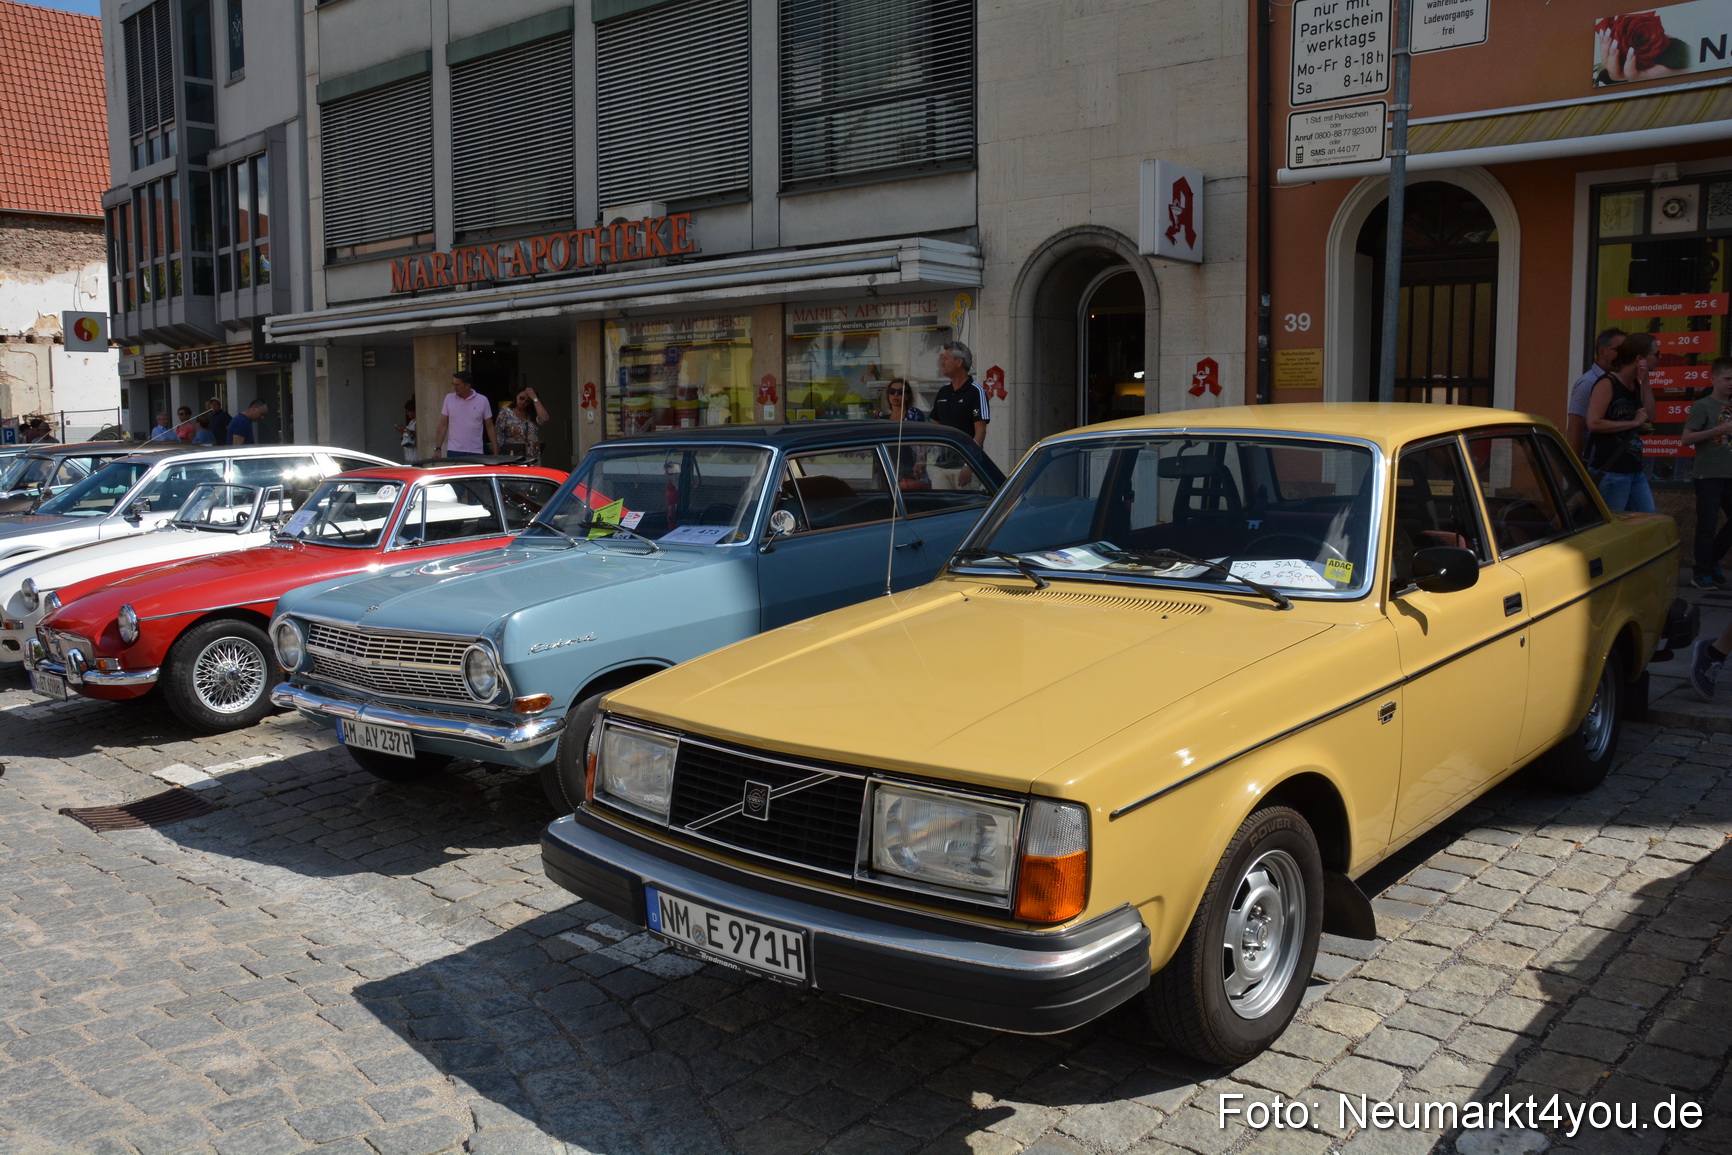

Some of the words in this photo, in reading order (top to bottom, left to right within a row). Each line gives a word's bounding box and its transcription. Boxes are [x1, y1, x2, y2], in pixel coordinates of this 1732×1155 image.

[1314, 2, 1338, 17] nur
[1301, 10, 1383, 37] Parkschein
[1424, 9, 1474, 25] Ladevorgangs
[1442, 25, 1455, 36] frei
[1307, 31, 1376, 53] werktags
[1297, 59, 1338, 77] Mo-Fr
[1297, 82, 1312, 95] Sa
[1334, 110, 1369, 121] Parkschein
[1295, 133, 1314, 142] Anruf
[1310, 148, 1326, 157] SMS
[389, 212, 696, 293] MARIEN-APOTHEKE
[794, 305, 848, 321] MARIEN
[854, 299, 939, 318] APOTHEKE
[1624, 302, 1684, 313] Neumodellage
[1695, 299, 1708, 309] 25
[1710, 299, 1718, 308] €
[629, 318, 674, 335] MARIEN
[679, 313, 747, 331] APOTHEKE
[865, 319, 886, 329] gesund
[1284, 312, 1312, 332] 39
[1678, 336, 1690, 345] 20
[1692, 336, 1700, 345] €
[169, 349, 209, 369] ESPRIT
[1684, 371, 1698, 380] 29
[1701, 371, 1709, 379] €
[1668, 406, 1682, 414] 35
[697, 528, 720, 536] 473
[1233, 561, 1258, 569] FOR
[1273, 560, 1314, 569] SALE
[1328, 559, 1352, 571] ADAC
[343, 722, 357, 744] AM
[365, 726, 378, 748] AY
[380, 730, 413, 755] 237H
[1249, 818, 1291, 848] POWER
[660, 896, 691, 939] NM
[705, 912, 724, 950] E
[728, 920, 803, 973] 971H
